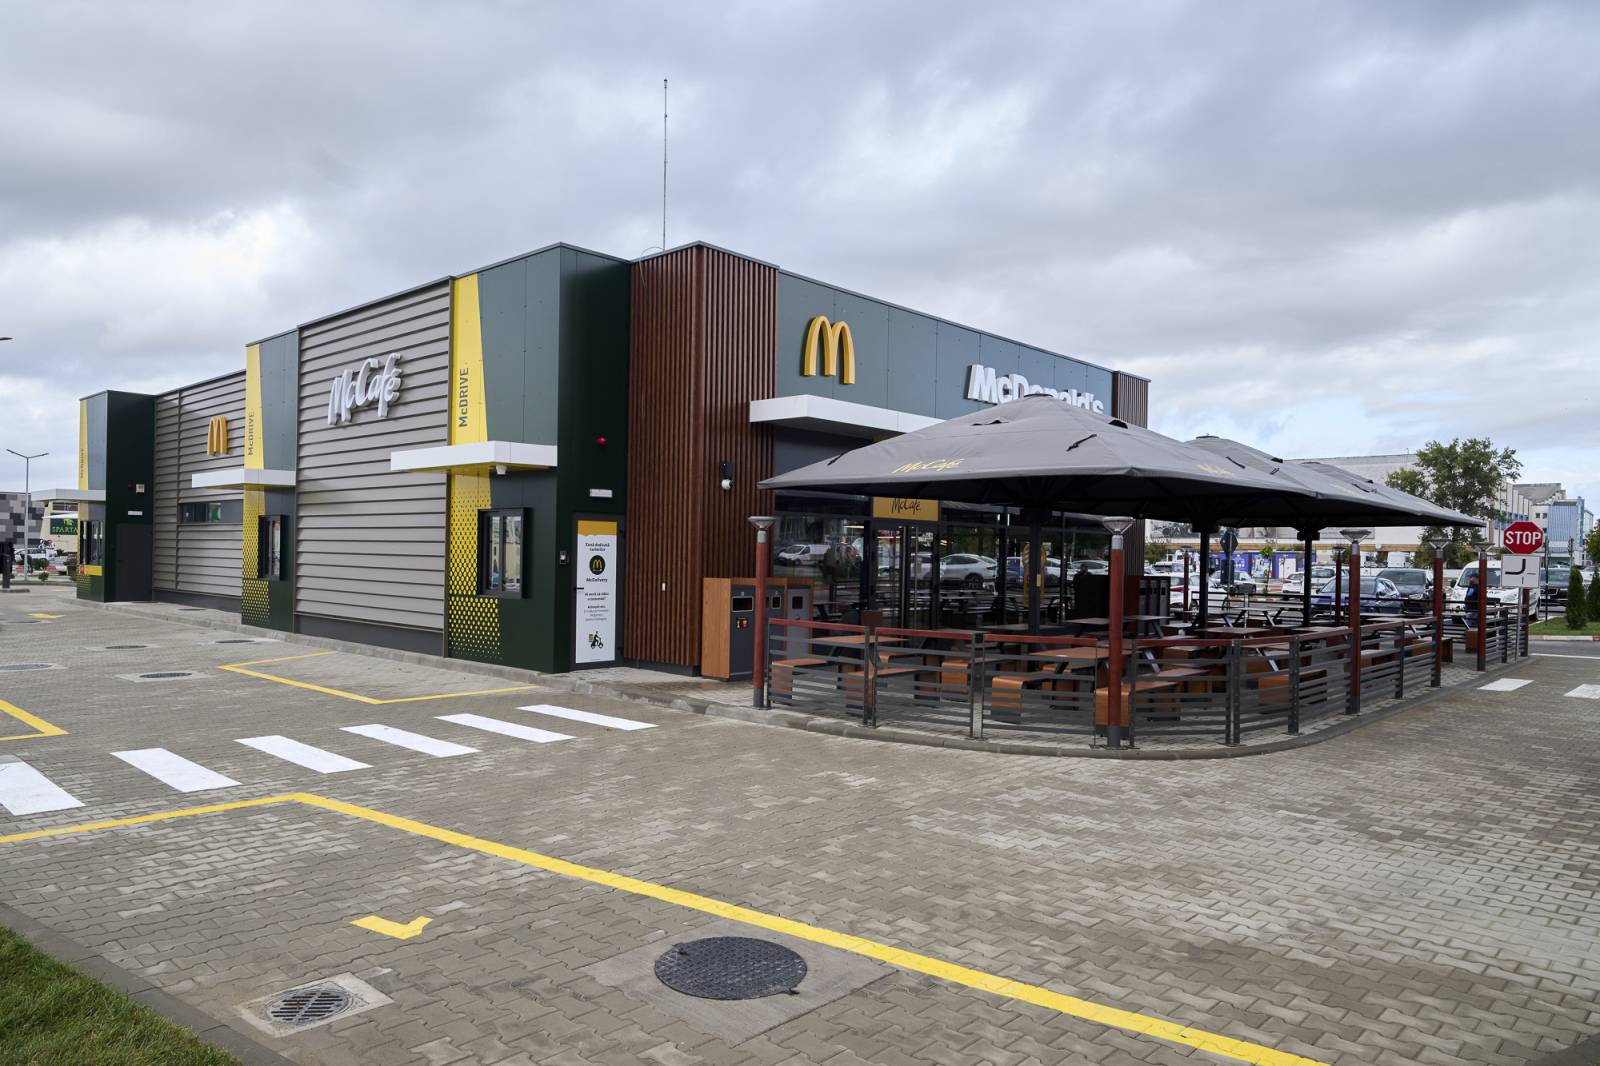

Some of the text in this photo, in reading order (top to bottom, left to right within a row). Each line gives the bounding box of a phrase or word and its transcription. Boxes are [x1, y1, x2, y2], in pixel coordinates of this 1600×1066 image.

[327, 353, 402, 425] McCafé
[458, 367, 469, 428] McDRIVE
[1505, 530, 1541, 545] STOP
